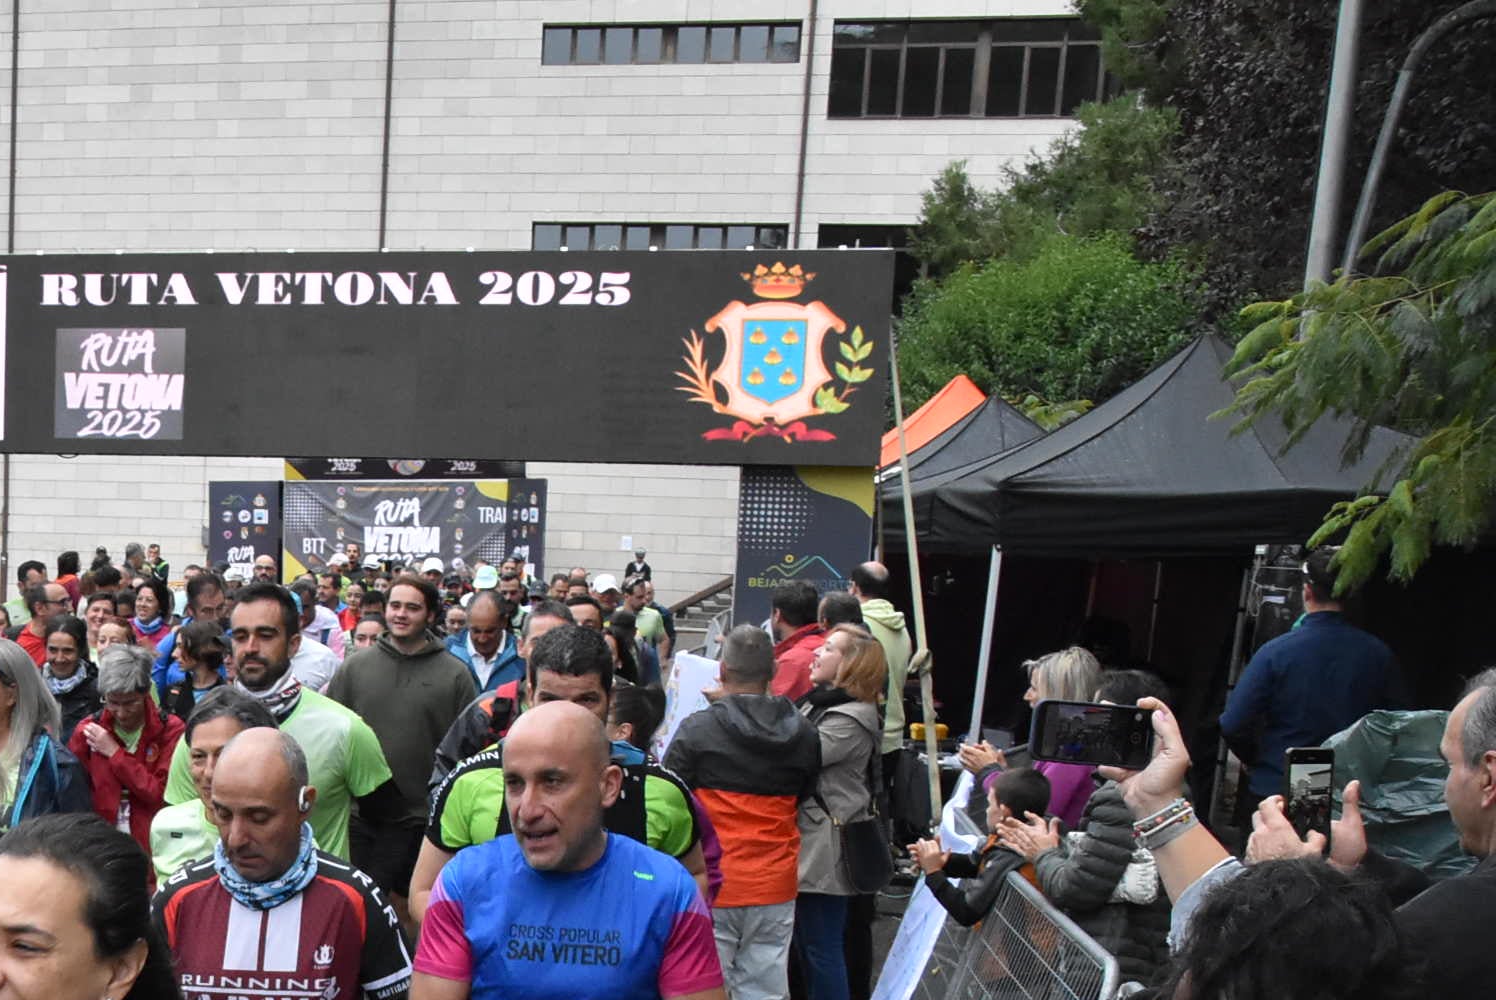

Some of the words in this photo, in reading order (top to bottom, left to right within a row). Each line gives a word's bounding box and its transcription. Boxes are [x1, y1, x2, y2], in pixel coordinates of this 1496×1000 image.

[40, 273, 199, 306] RUTA
[215, 271, 460, 306] VETONA
[478, 270, 631, 306] 2025
[80, 329, 156, 374] RUTA
[64, 372, 185, 410] VETONA
[77, 410, 161, 439] 2025
[374, 497, 421, 526] RUTA
[477, 507, 507, 523] TRAI
[302, 538, 327, 554] BTT
[363, 526, 441, 553] VETONA
[509, 924, 554, 940] CROSS
[559, 927, 621, 944] POPULAR
[506, 940, 546, 962] SAN
[552, 943, 622, 967] VITERO
[181, 974, 332, 990] RUNNING
